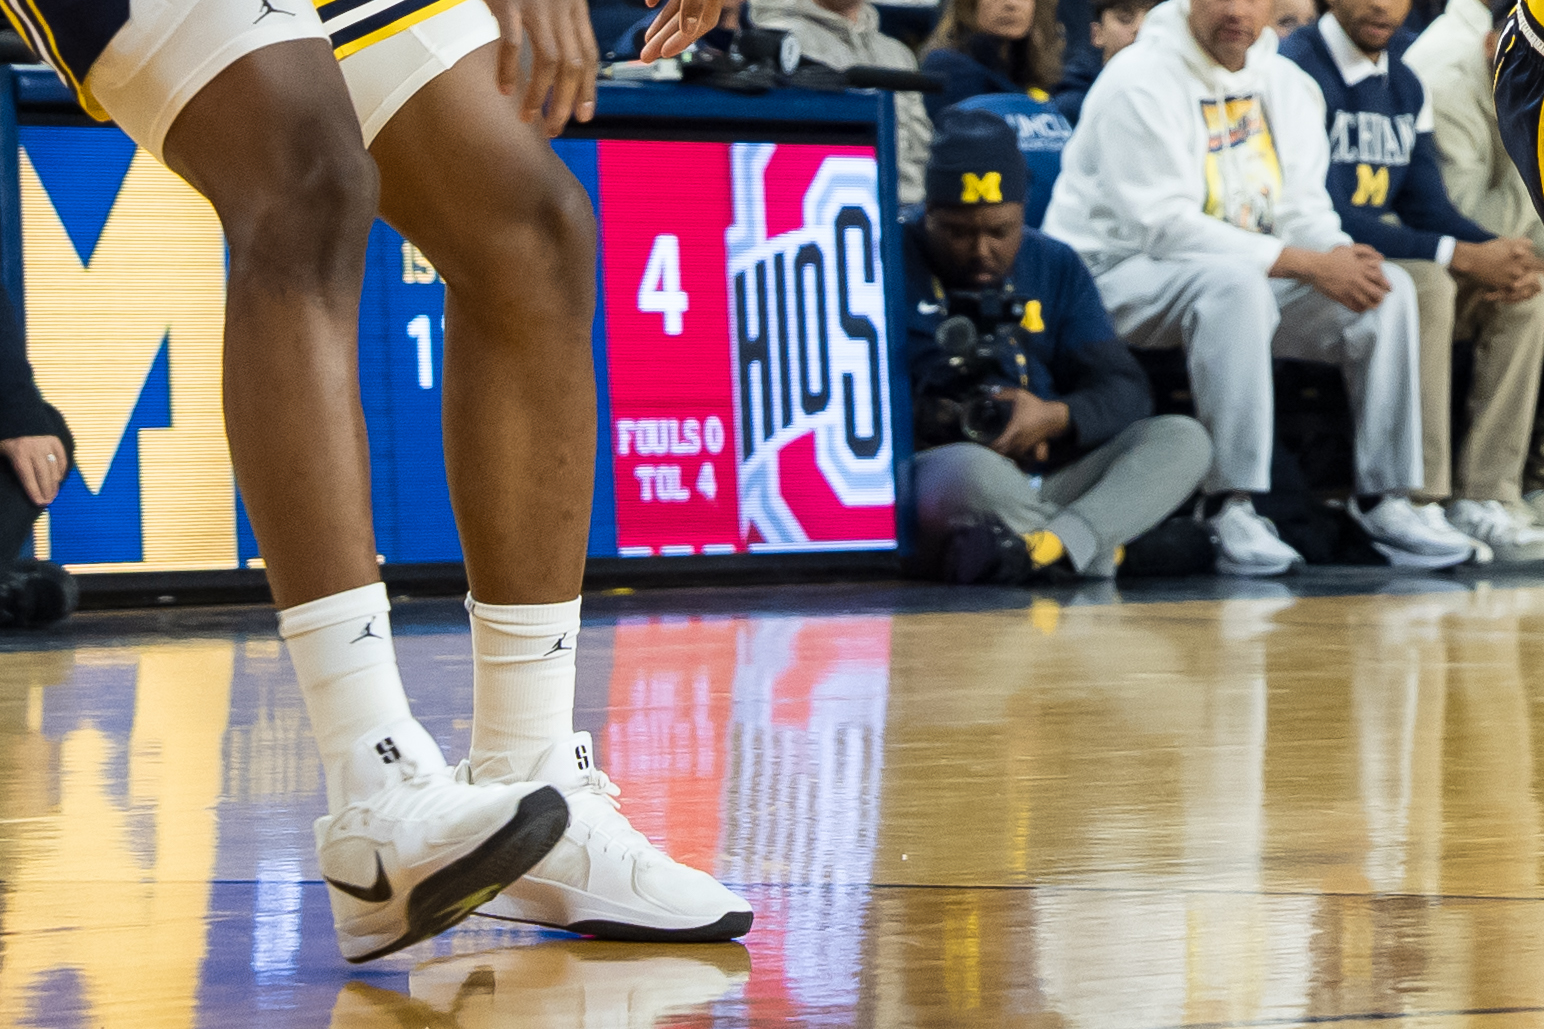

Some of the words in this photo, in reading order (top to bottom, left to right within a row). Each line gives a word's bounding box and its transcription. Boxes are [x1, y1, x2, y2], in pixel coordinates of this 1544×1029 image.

[960, 171, 1003, 204] M
[1352, 163, 1389, 208] M
[637, 233, 690, 336] 4
[616, 417, 702, 457] FOULS
[696, 461, 718, 502] 4
[375, 737, 401, 765] S
[574, 744, 590, 771] S
